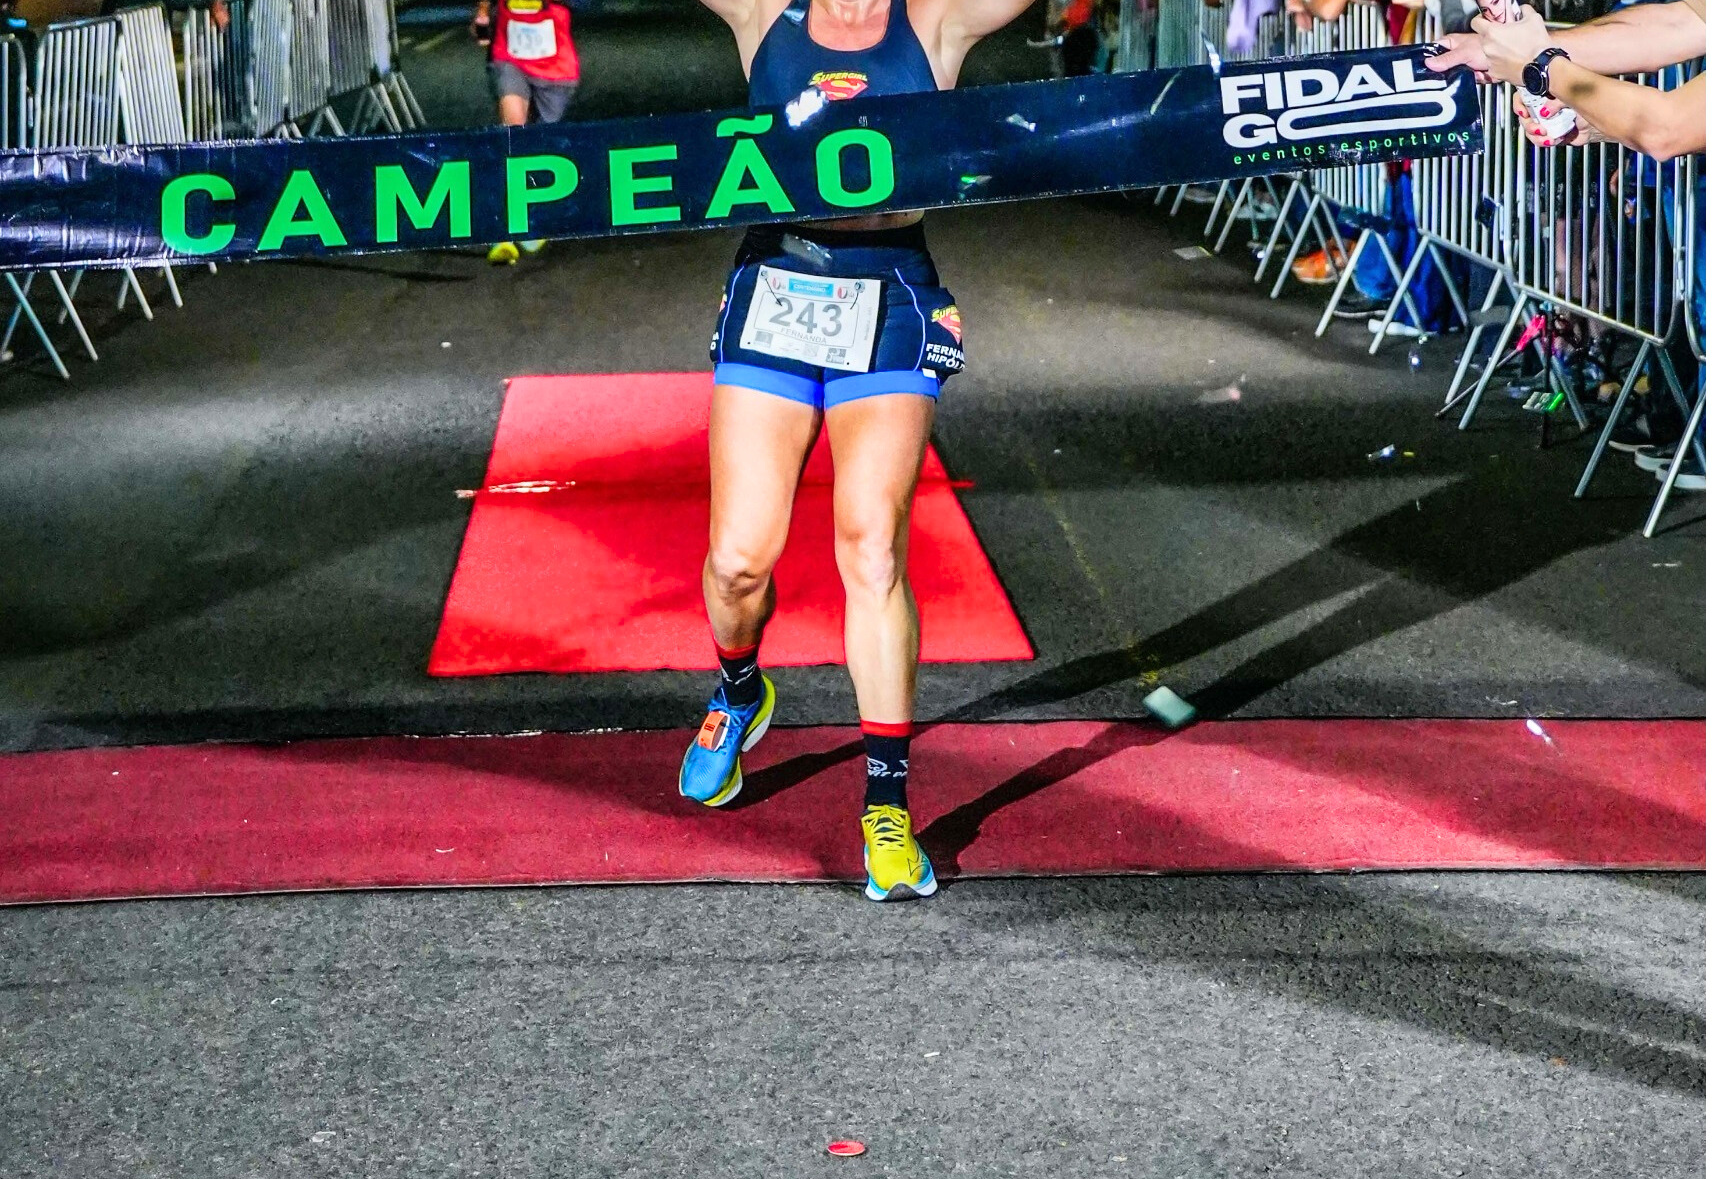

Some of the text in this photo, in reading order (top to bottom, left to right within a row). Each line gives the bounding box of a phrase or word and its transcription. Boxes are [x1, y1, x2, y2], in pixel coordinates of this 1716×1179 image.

[809, 72, 868, 86] SUPERGIRL
[1220, 59, 1447, 114] FIDAL
[1234, 130, 1470, 165] eventos esportivos
[161, 114, 895, 252] CAMPEÃO
[768, 296, 843, 338] 243
[779, 327, 827, 345] FERNANDA
